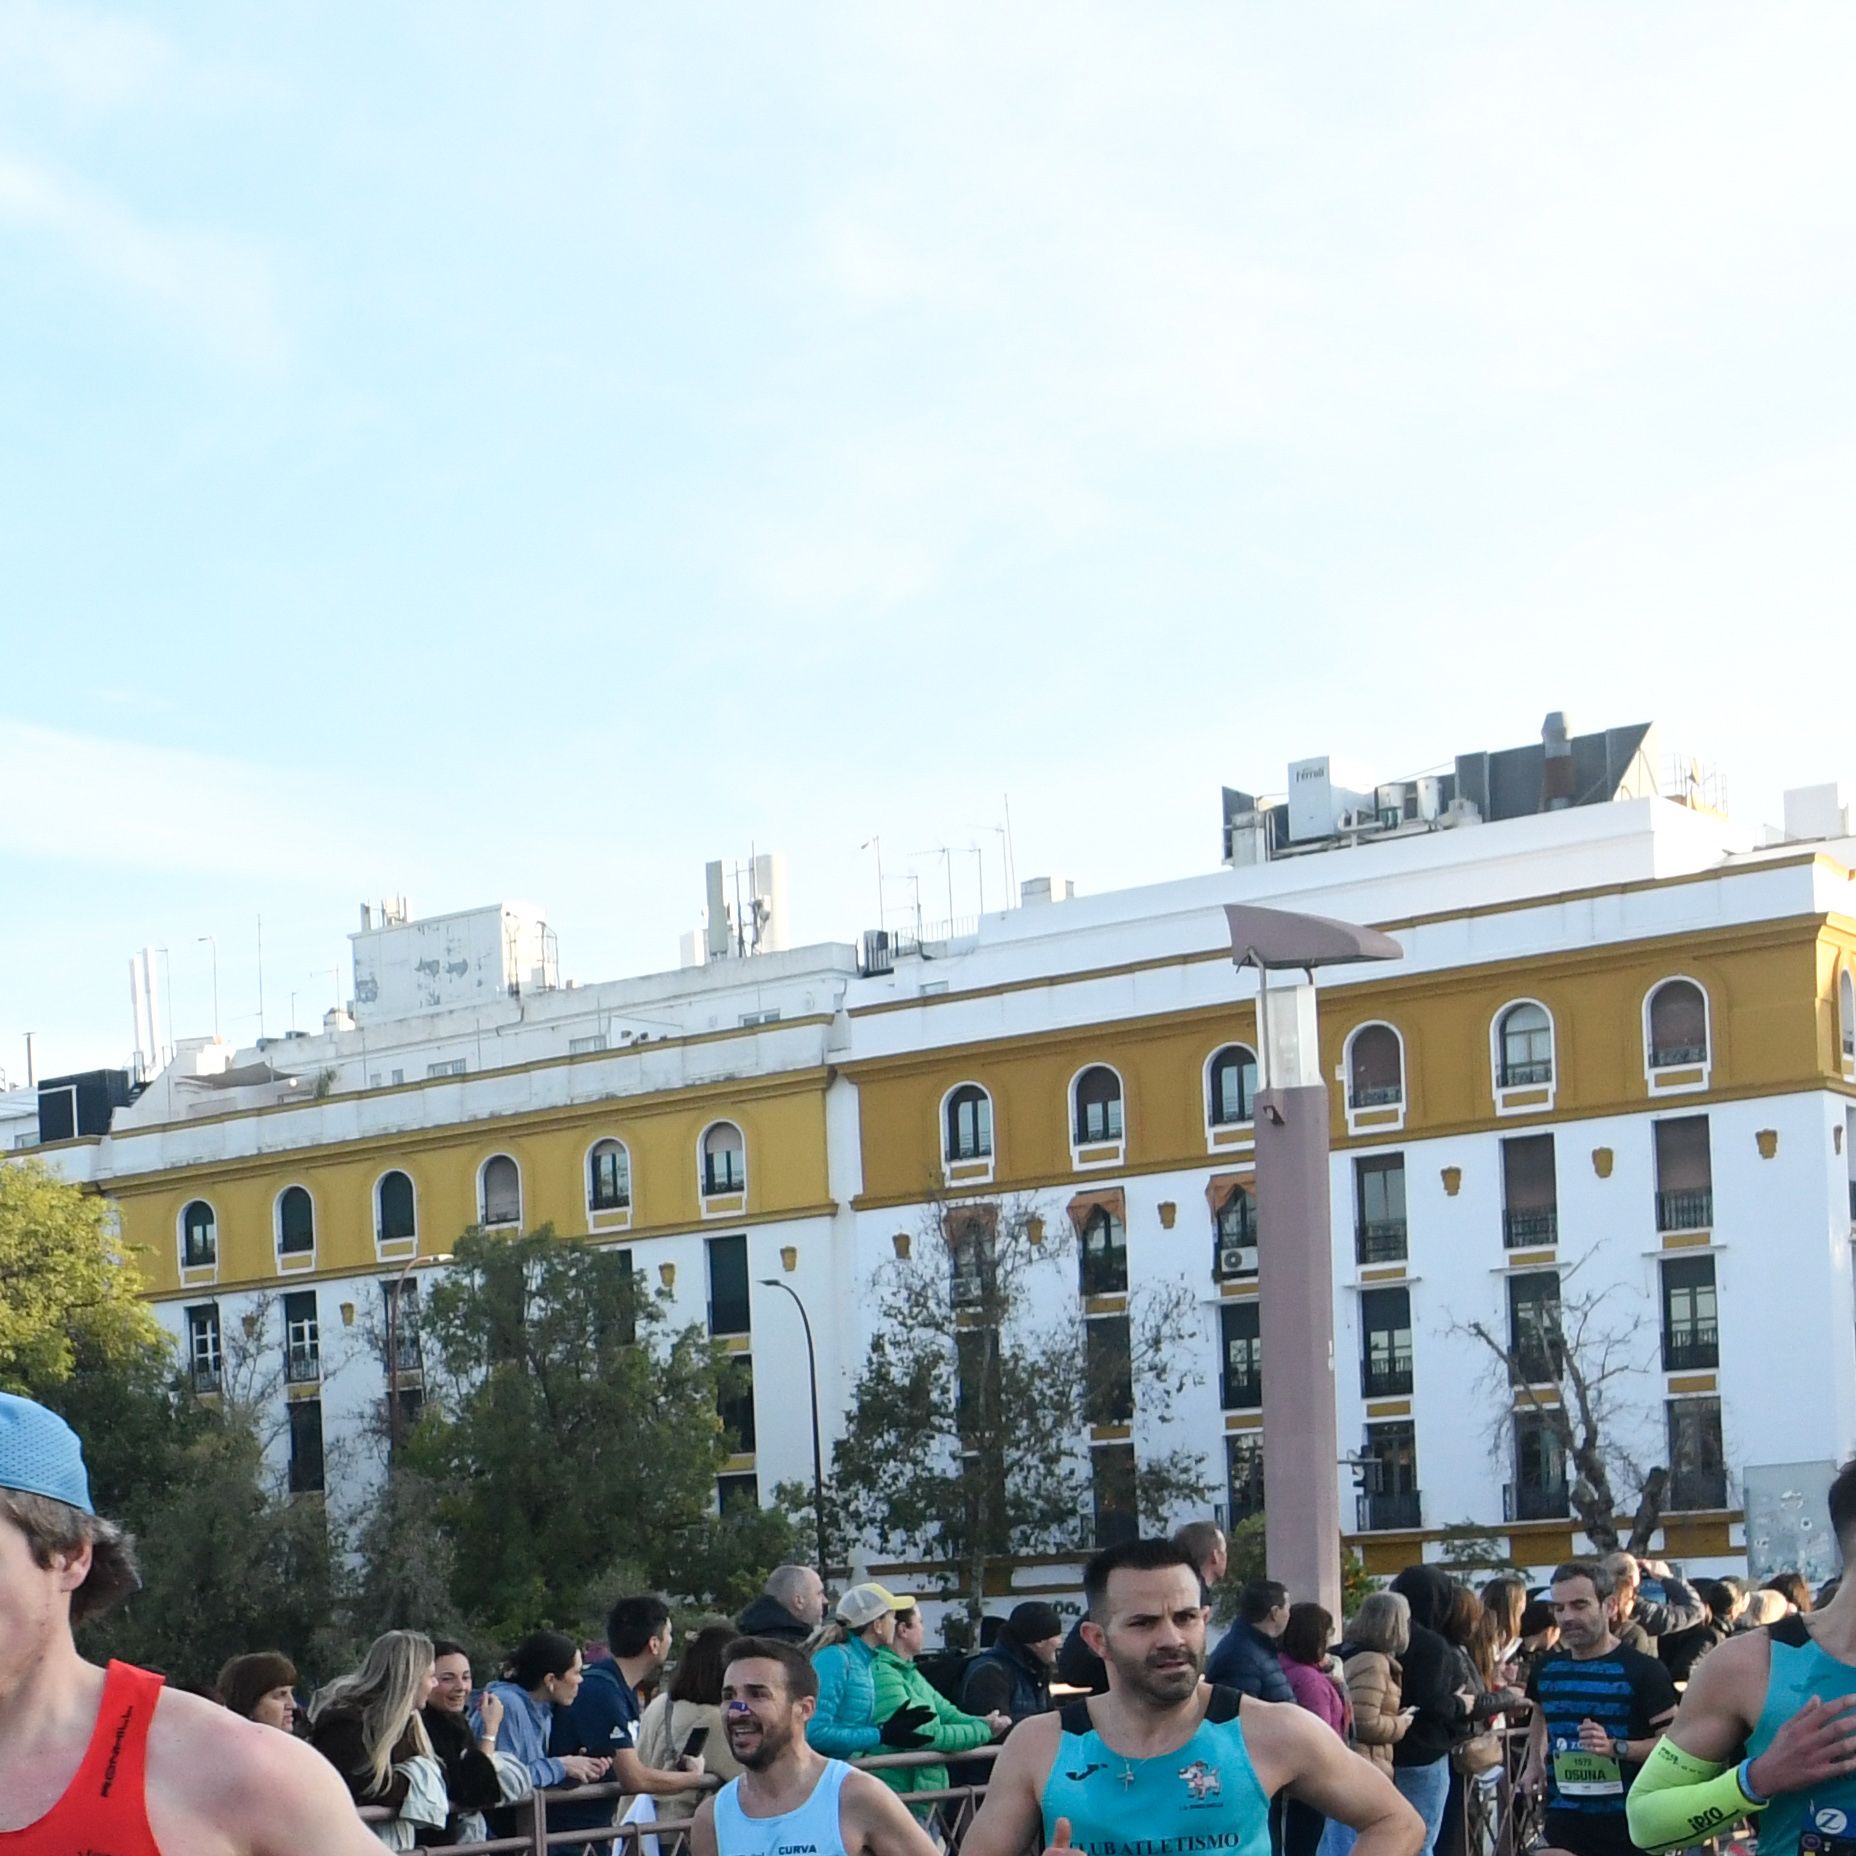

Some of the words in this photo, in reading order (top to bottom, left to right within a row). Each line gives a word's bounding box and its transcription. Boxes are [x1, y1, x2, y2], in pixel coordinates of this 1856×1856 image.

[1565, 1769, 1606, 1781] OSUNA
[778, 1844, 817, 1855] CURVA
[1121, 1832, 1239, 1856] ATLETISMO
